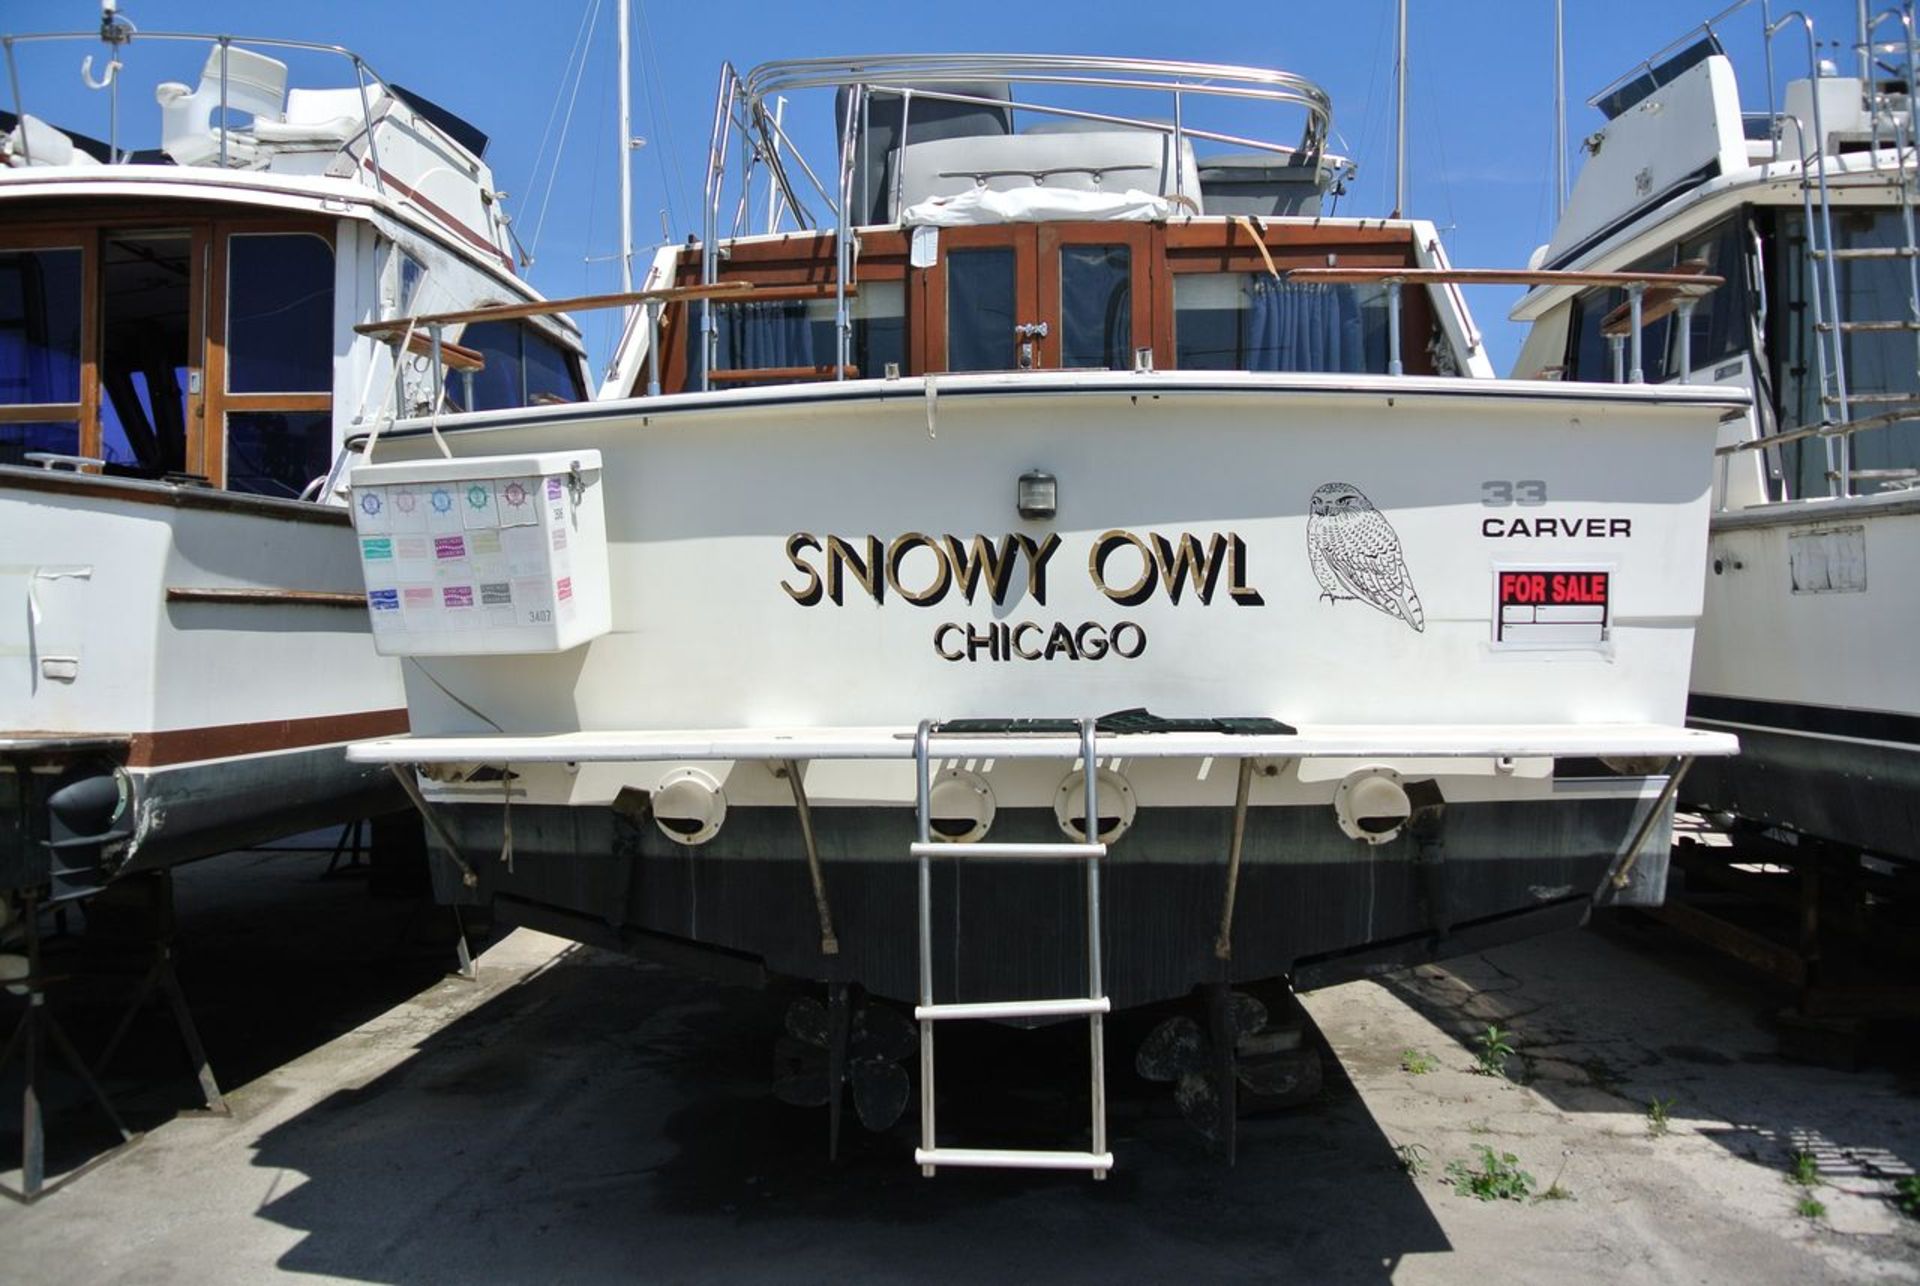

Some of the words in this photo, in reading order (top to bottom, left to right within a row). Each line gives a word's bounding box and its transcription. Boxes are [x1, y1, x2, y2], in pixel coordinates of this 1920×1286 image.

[1481, 480, 1548, 507] 33
[1482, 518, 1632, 538] CARVER
[781, 530, 1062, 607] SNOWY
[1088, 529, 1265, 607] OWL
[1502, 575, 1546, 602] FOR
[1551, 575, 1606, 602] SALE
[529, 610, 552, 622] 3407
[934, 620, 1147, 662] CHICAGO
